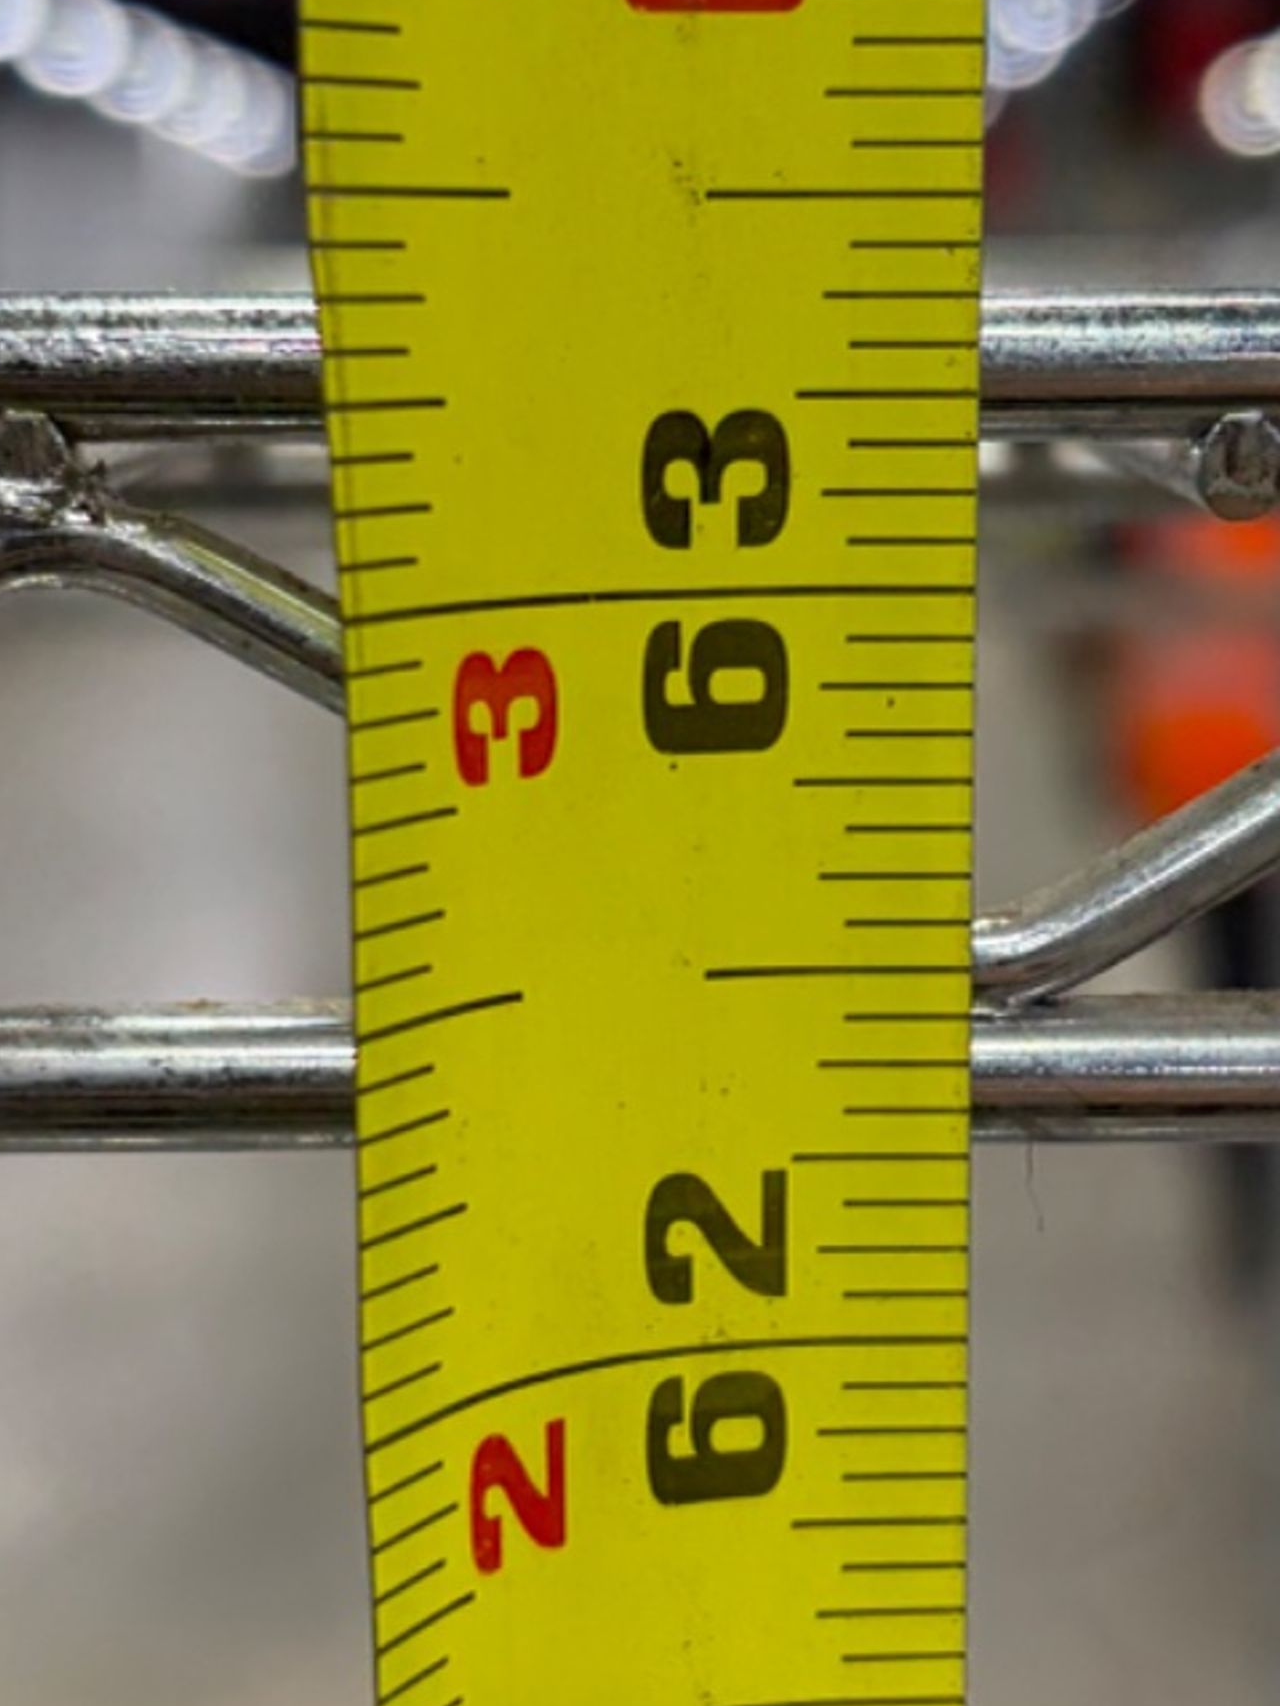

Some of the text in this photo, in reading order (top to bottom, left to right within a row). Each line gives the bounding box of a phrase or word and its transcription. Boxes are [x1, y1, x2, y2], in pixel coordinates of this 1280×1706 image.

[642, 408, 791, 755] 63
[453, 646, 558, 786] 3
[644, 1169, 788, 1507] 62
[469, 1418, 565, 1575] 2
